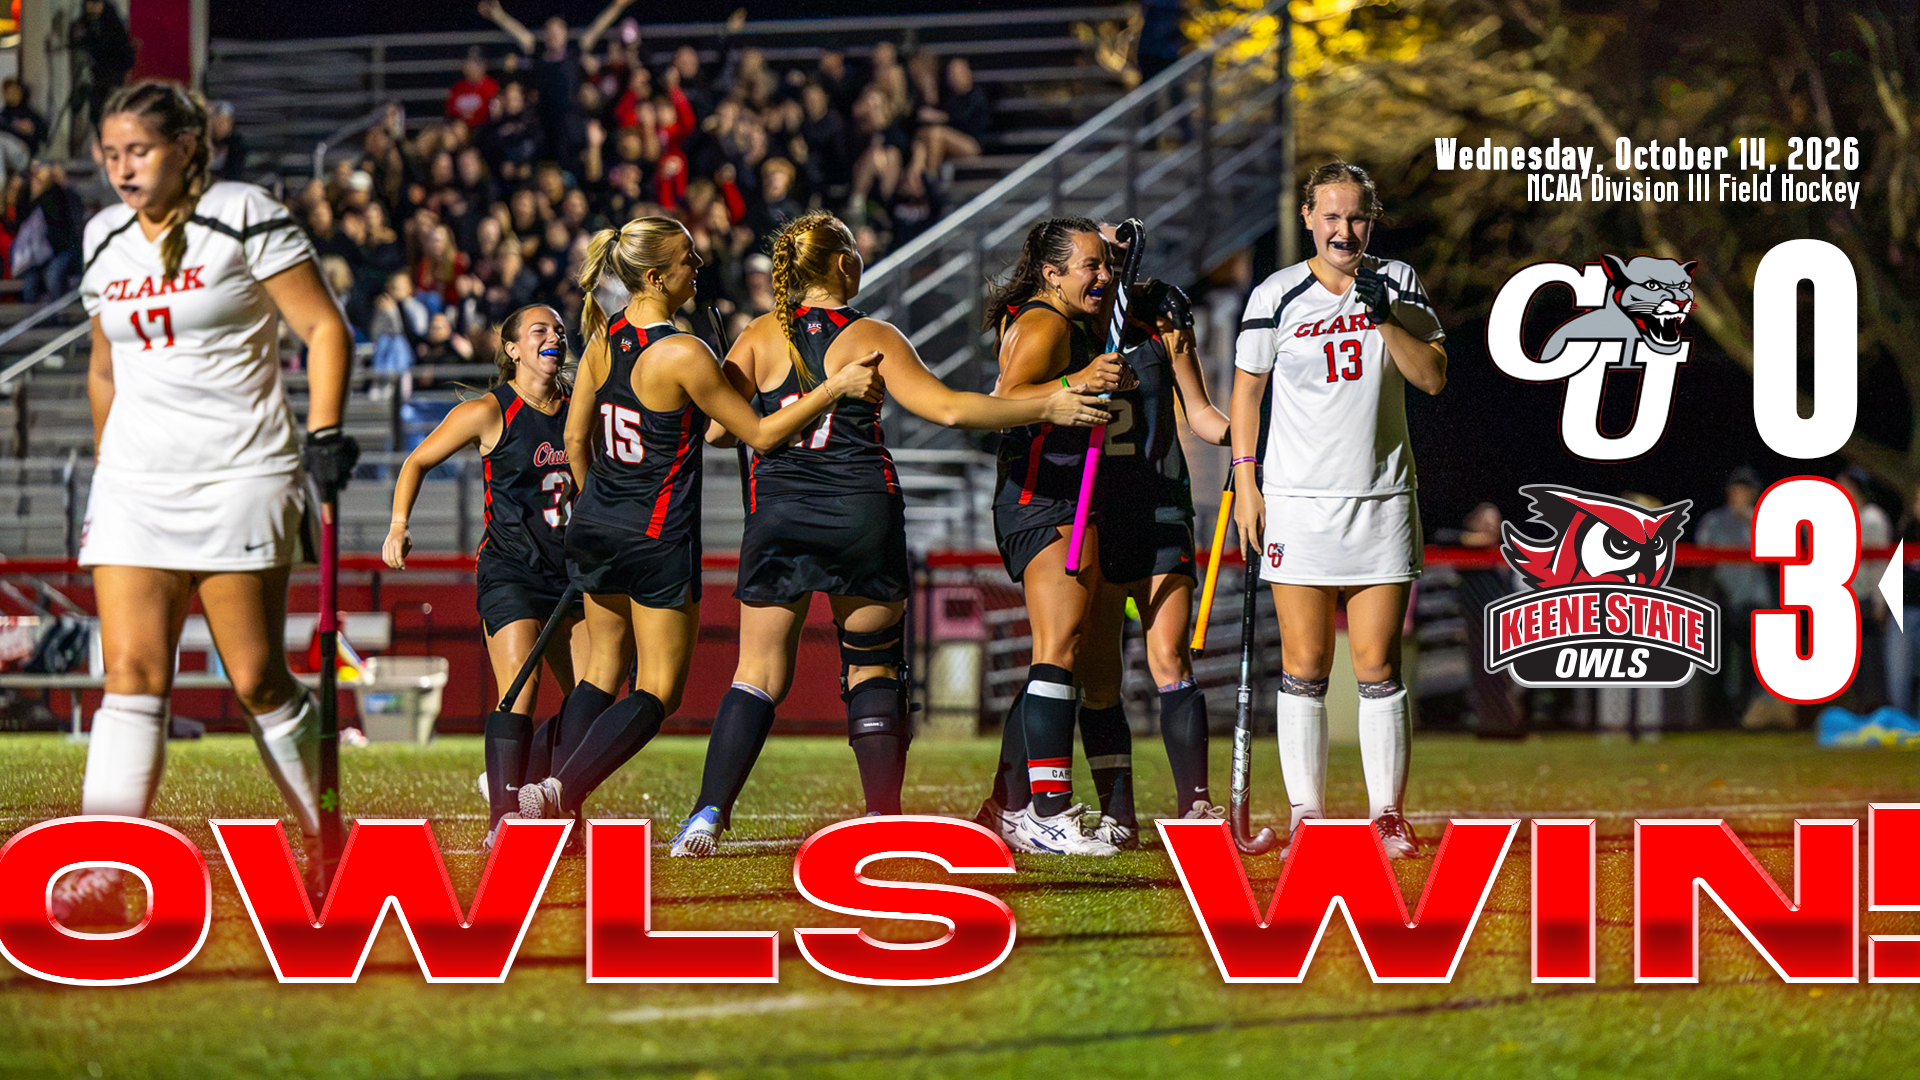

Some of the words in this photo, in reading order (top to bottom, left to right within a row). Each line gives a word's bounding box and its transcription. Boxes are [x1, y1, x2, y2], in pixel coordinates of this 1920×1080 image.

[103, 265, 205, 301] CLARK
[130, 306, 175, 351] 17
[1323, 339, 1363, 383] 13
[600, 402, 645, 464] 15
[1104, 398, 1135, 456] 2
[542, 471, 572, 528] 3
